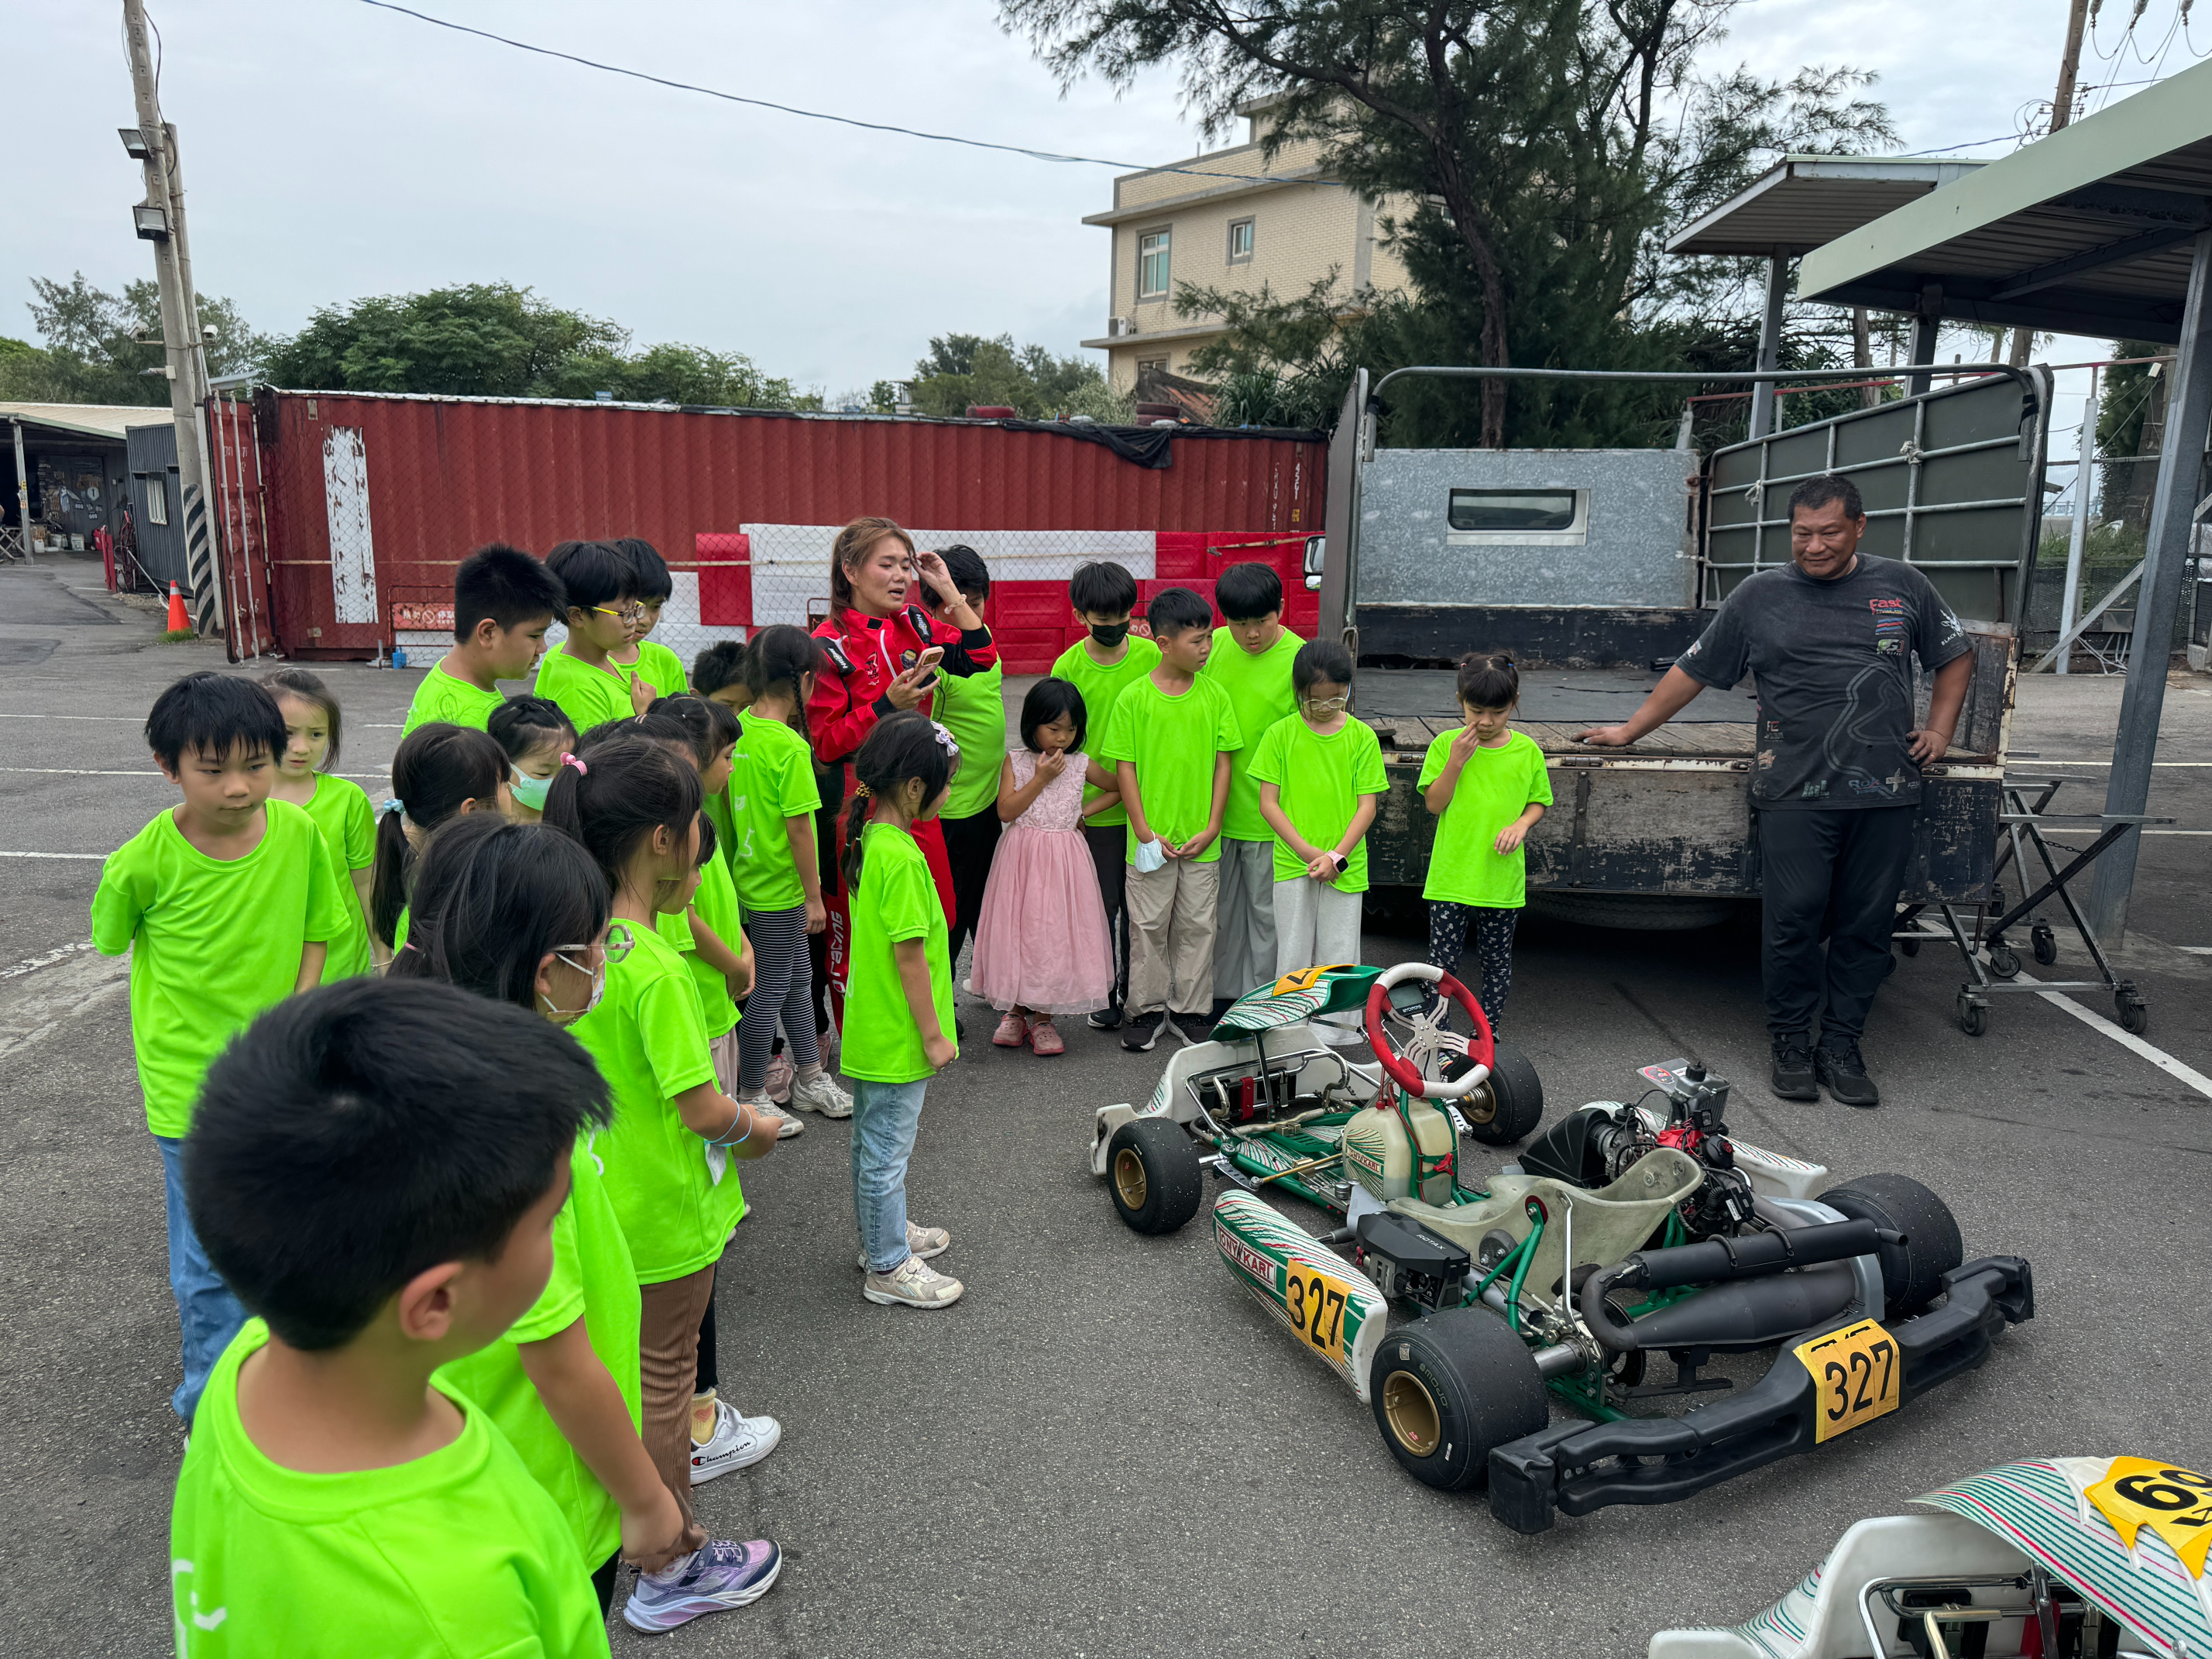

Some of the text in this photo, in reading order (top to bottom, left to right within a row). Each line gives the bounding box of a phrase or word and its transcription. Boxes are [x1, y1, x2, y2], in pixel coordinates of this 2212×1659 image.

[1870, 598, 1903, 614] Fast
[1941, 632, 1956, 646] BLACK
[1416, 1234, 1446, 1249] ROTAX
[1242, 1246, 1274, 1279] KART
[1288, 1275, 1345, 1350] 327
[1826, 1339, 1894, 1421] 327
[692, 1441, 751, 1466] Champion
